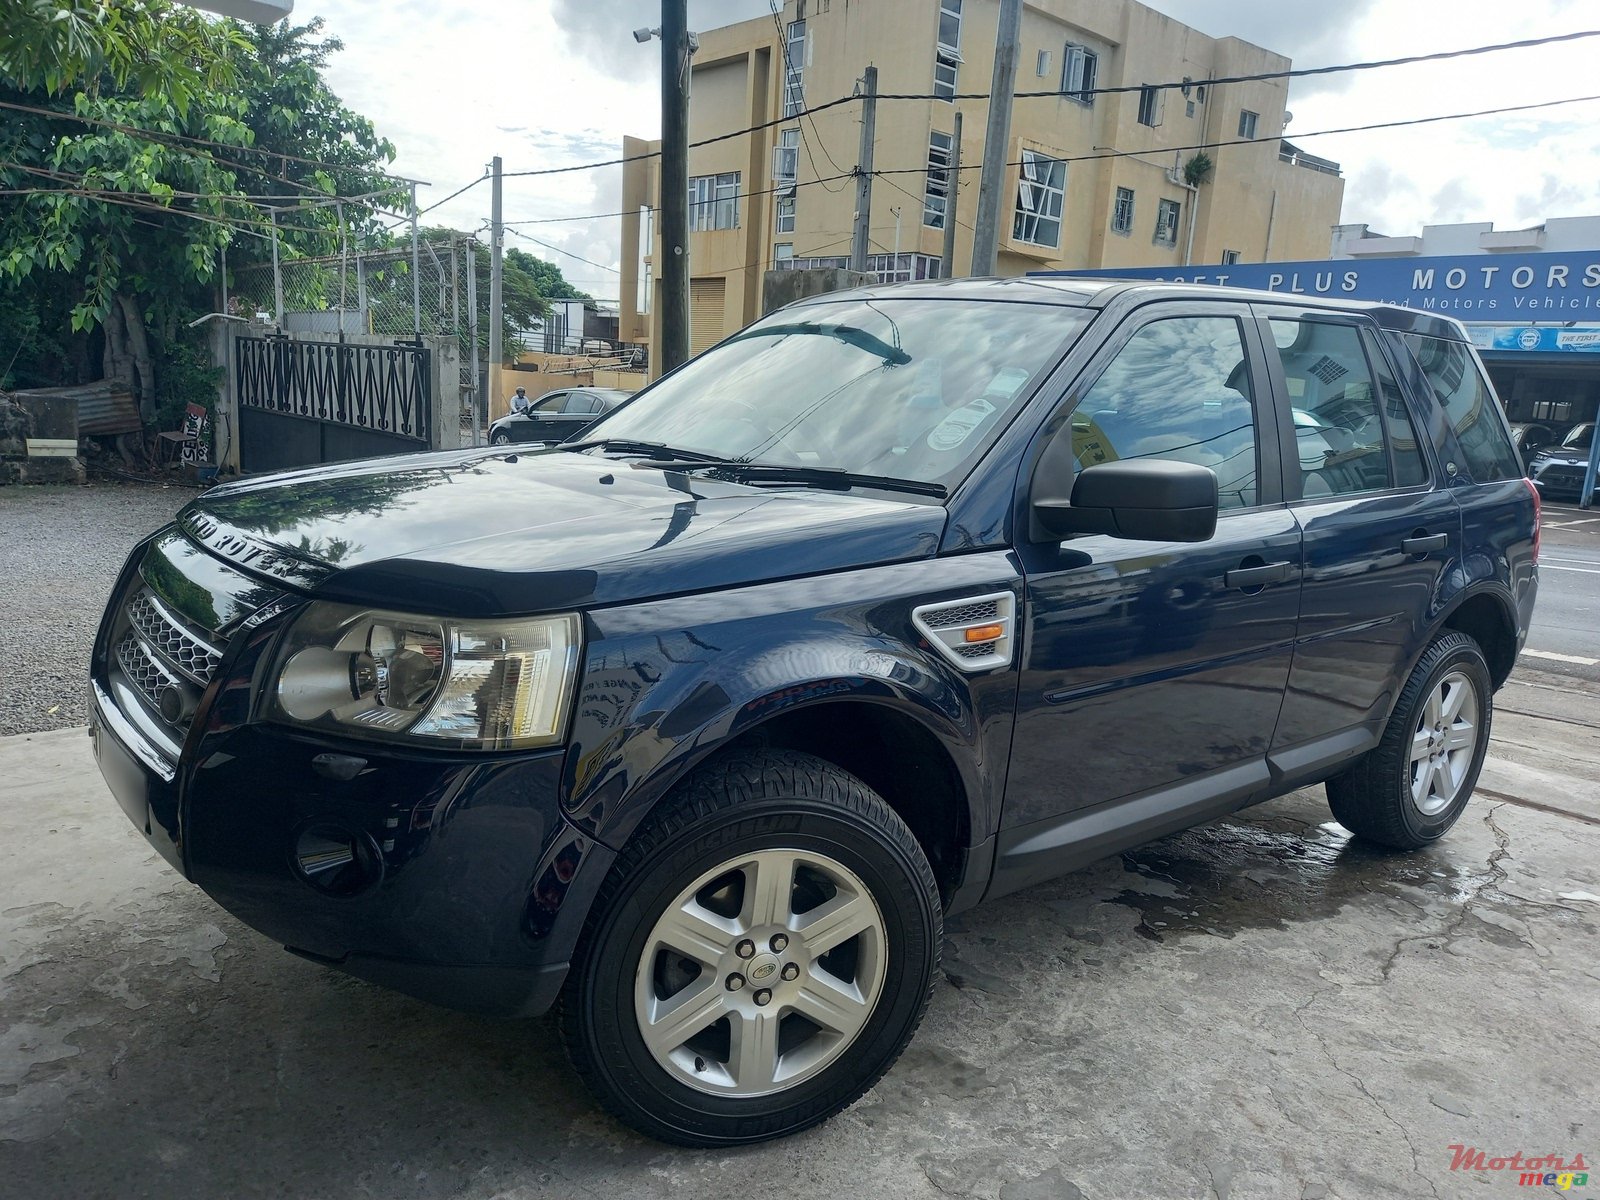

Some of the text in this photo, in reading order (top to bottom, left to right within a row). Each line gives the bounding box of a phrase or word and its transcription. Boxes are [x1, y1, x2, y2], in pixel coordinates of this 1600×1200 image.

[1268, 264, 1600, 292] PLUS MOTORS
[1423, 297, 1497, 309] Motors
[1513, 295, 1600, 309] Vehicle
[213, 535, 299, 578] ROVER
